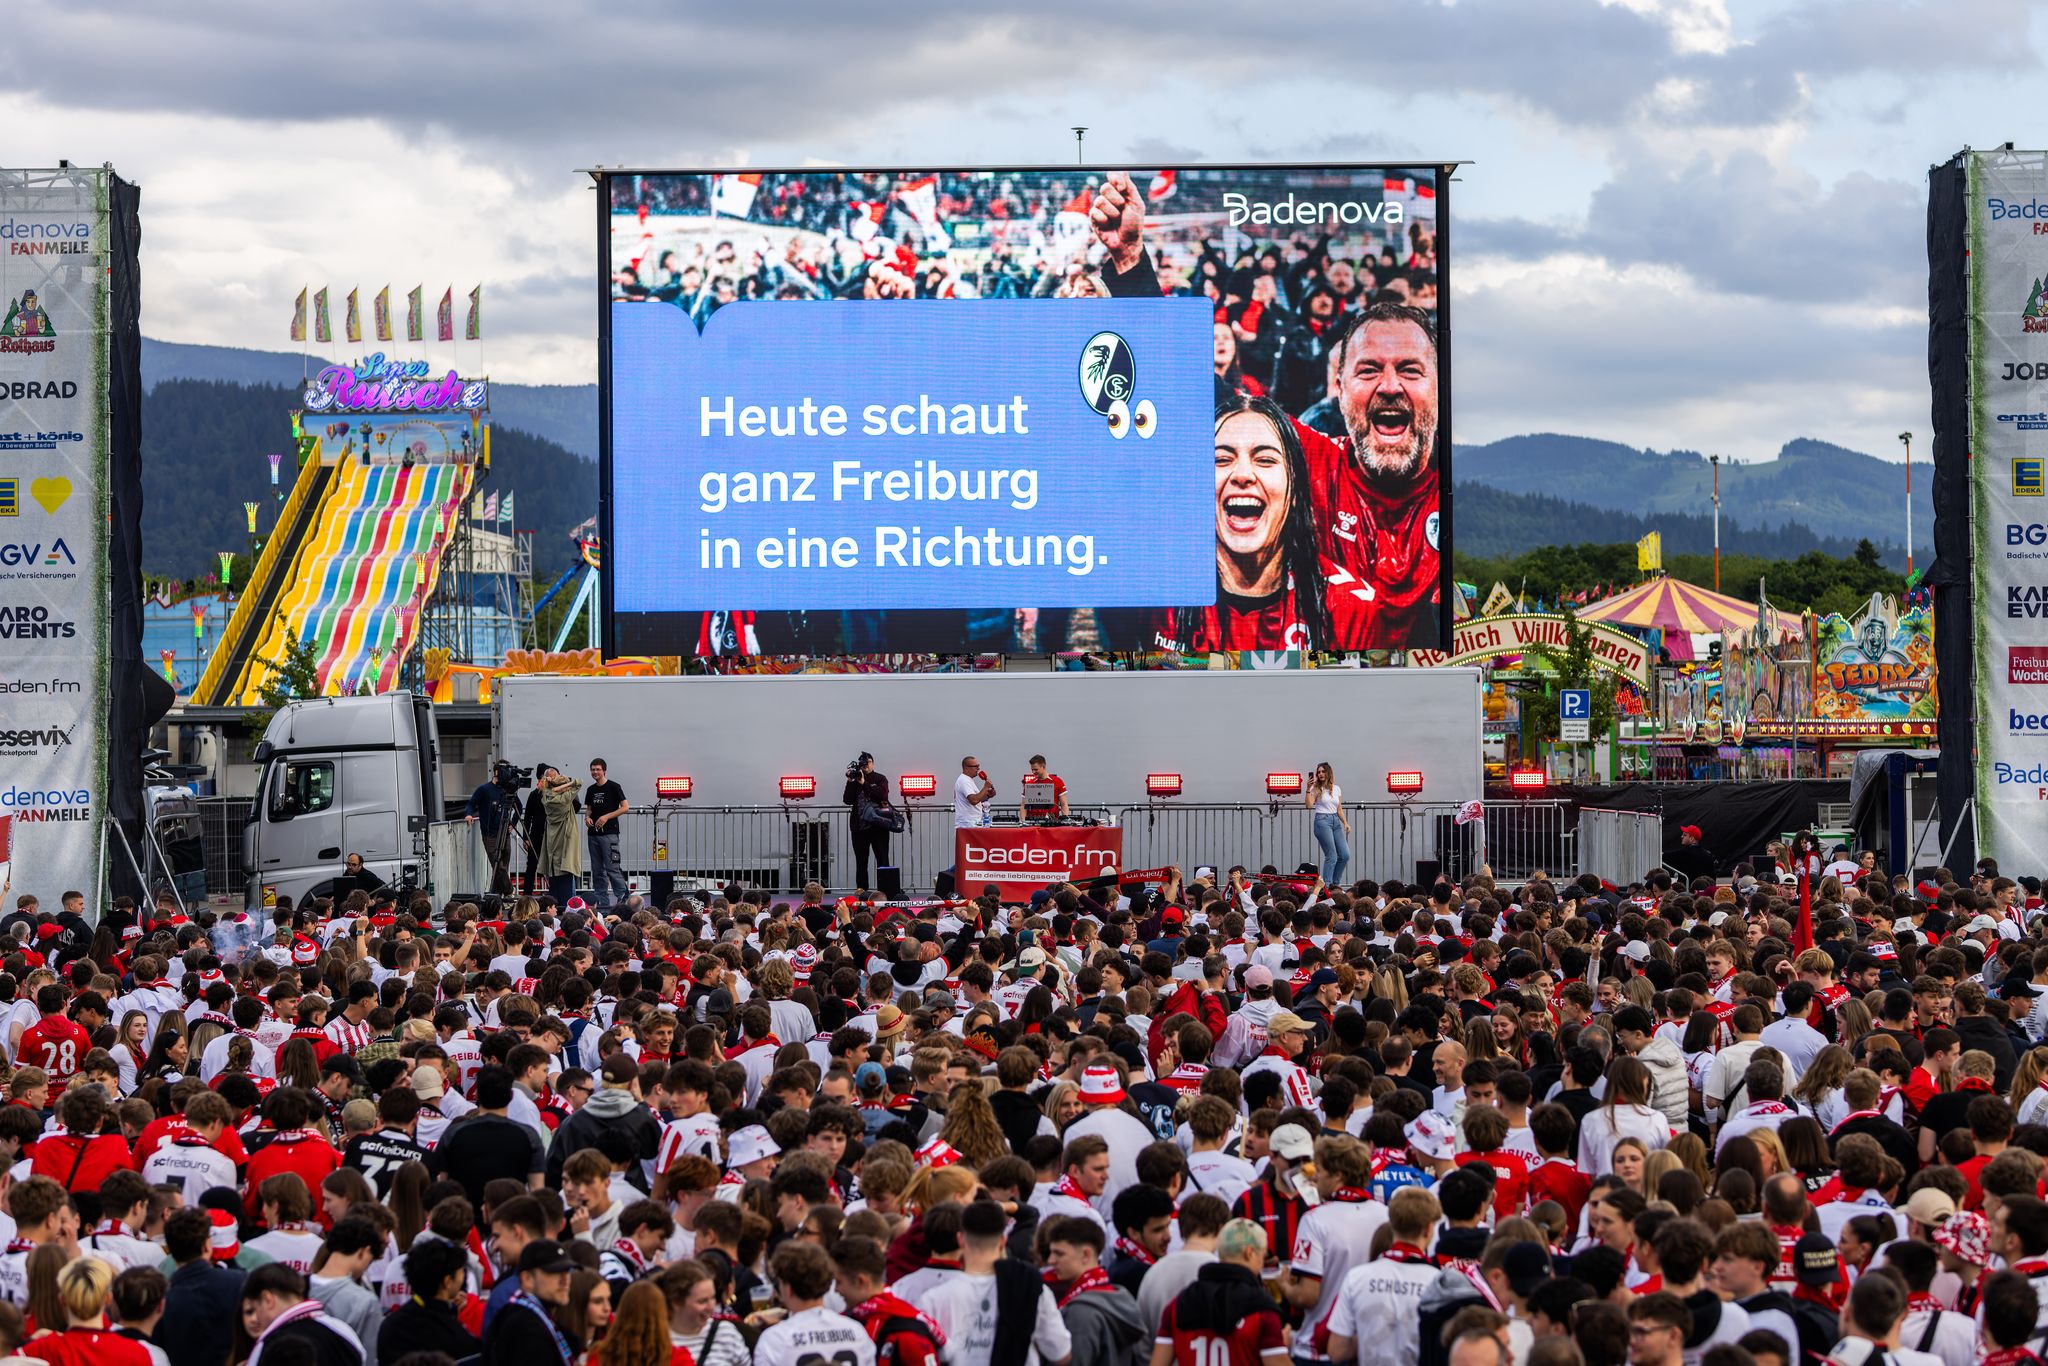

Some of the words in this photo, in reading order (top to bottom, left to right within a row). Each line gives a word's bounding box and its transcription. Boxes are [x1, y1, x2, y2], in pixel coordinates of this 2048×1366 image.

[1223, 193, 1404, 226] Badenova
[11, 241, 88, 255] FANMEILE
[0, 336, 55, 356] Rothaus
[355, 352, 429, 379] Super
[304, 365, 487, 409] Rutsche
[700, 396, 848, 437] Heute
[862, 395, 1029, 435] schaut
[1997, 412, 2047, 421] ernst
[37, 431, 83, 441] könig
[699, 468, 816, 513] ganz
[833, 460, 1039, 510] Freiburg
[2007, 524, 2048, 545] BG
[700, 529, 742, 569] in
[756, 528, 859, 568] eine
[875, 526, 1109, 576] Richtung.
[17, 572, 76, 580] Versicherungen
[1826, 662, 1916, 690] TEDDY
[1566, 694, 1581, 715] P
[1, 786, 90, 806] denova
[966, 843, 1117, 868] baden.fm
[1008, 873, 1066, 881] lieblingssongs
[42, 1039, 76, 1075] 28
[359, 1140, 423, 1162] scfreiburg
[153, 1157, 211, 1174] scfreiburg
[1374, 1171, 1413, 1182] MEYER
[792, 1332, 808, 1346] SC
[809, 1329, 857, 1344] FREIBURG
[1190, 1337, 1232, 1366] 10
